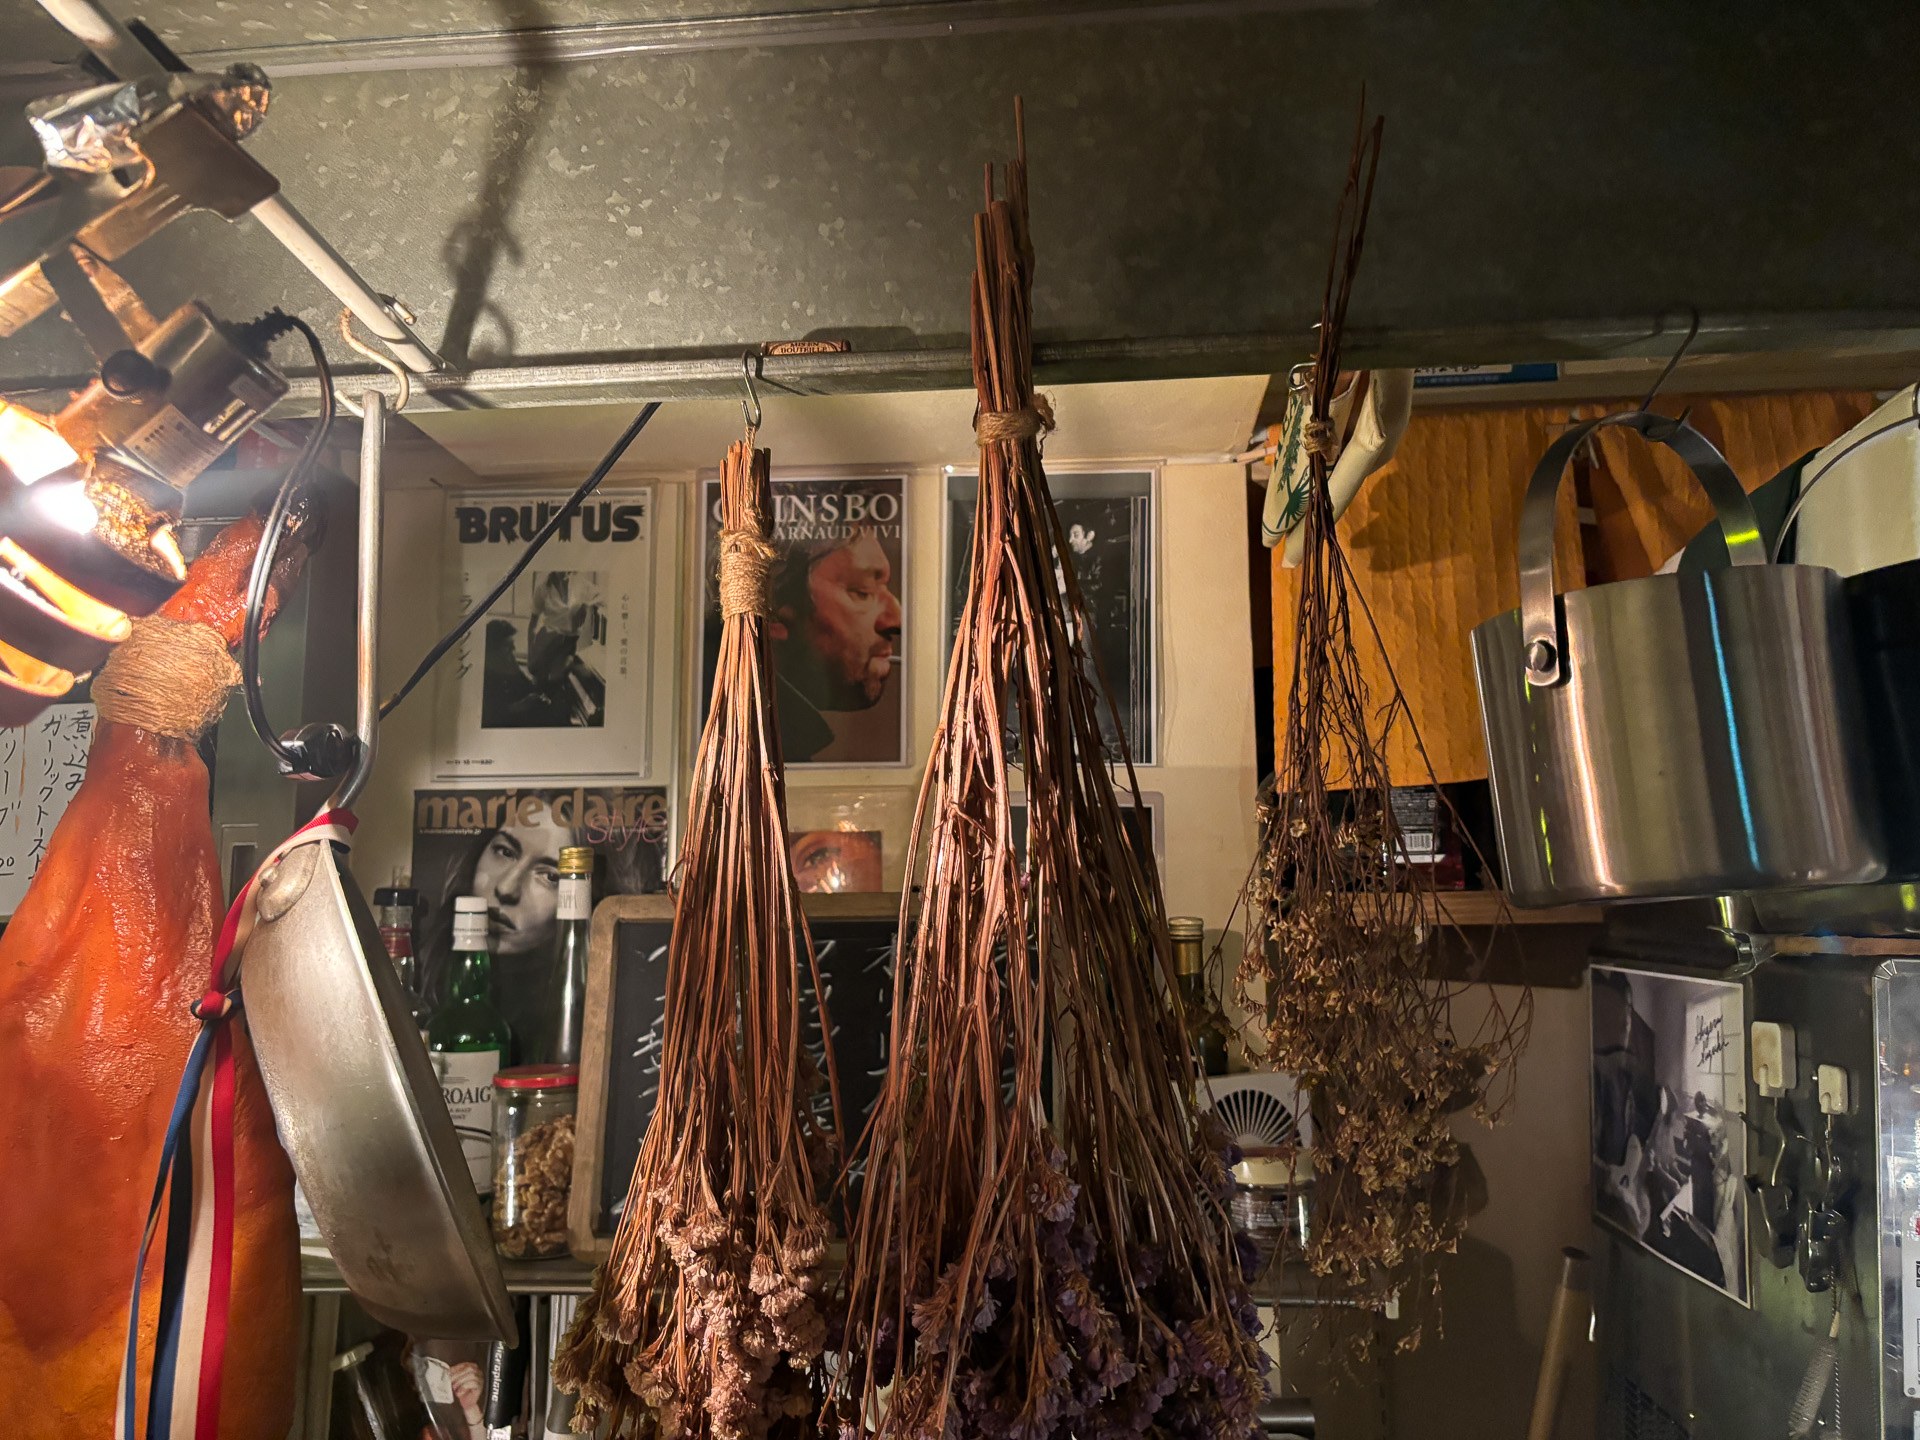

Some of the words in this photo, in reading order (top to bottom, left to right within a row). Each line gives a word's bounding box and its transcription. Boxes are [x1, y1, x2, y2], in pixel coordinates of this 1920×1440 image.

[455, 501, 645, 544] BRUTUS
[713, 493, 903, 522] INSBO
[775, 525, 855, 540] ARNAUD
[418, 788, 544, 829] marie
[552, 786, 667, 829] claire
